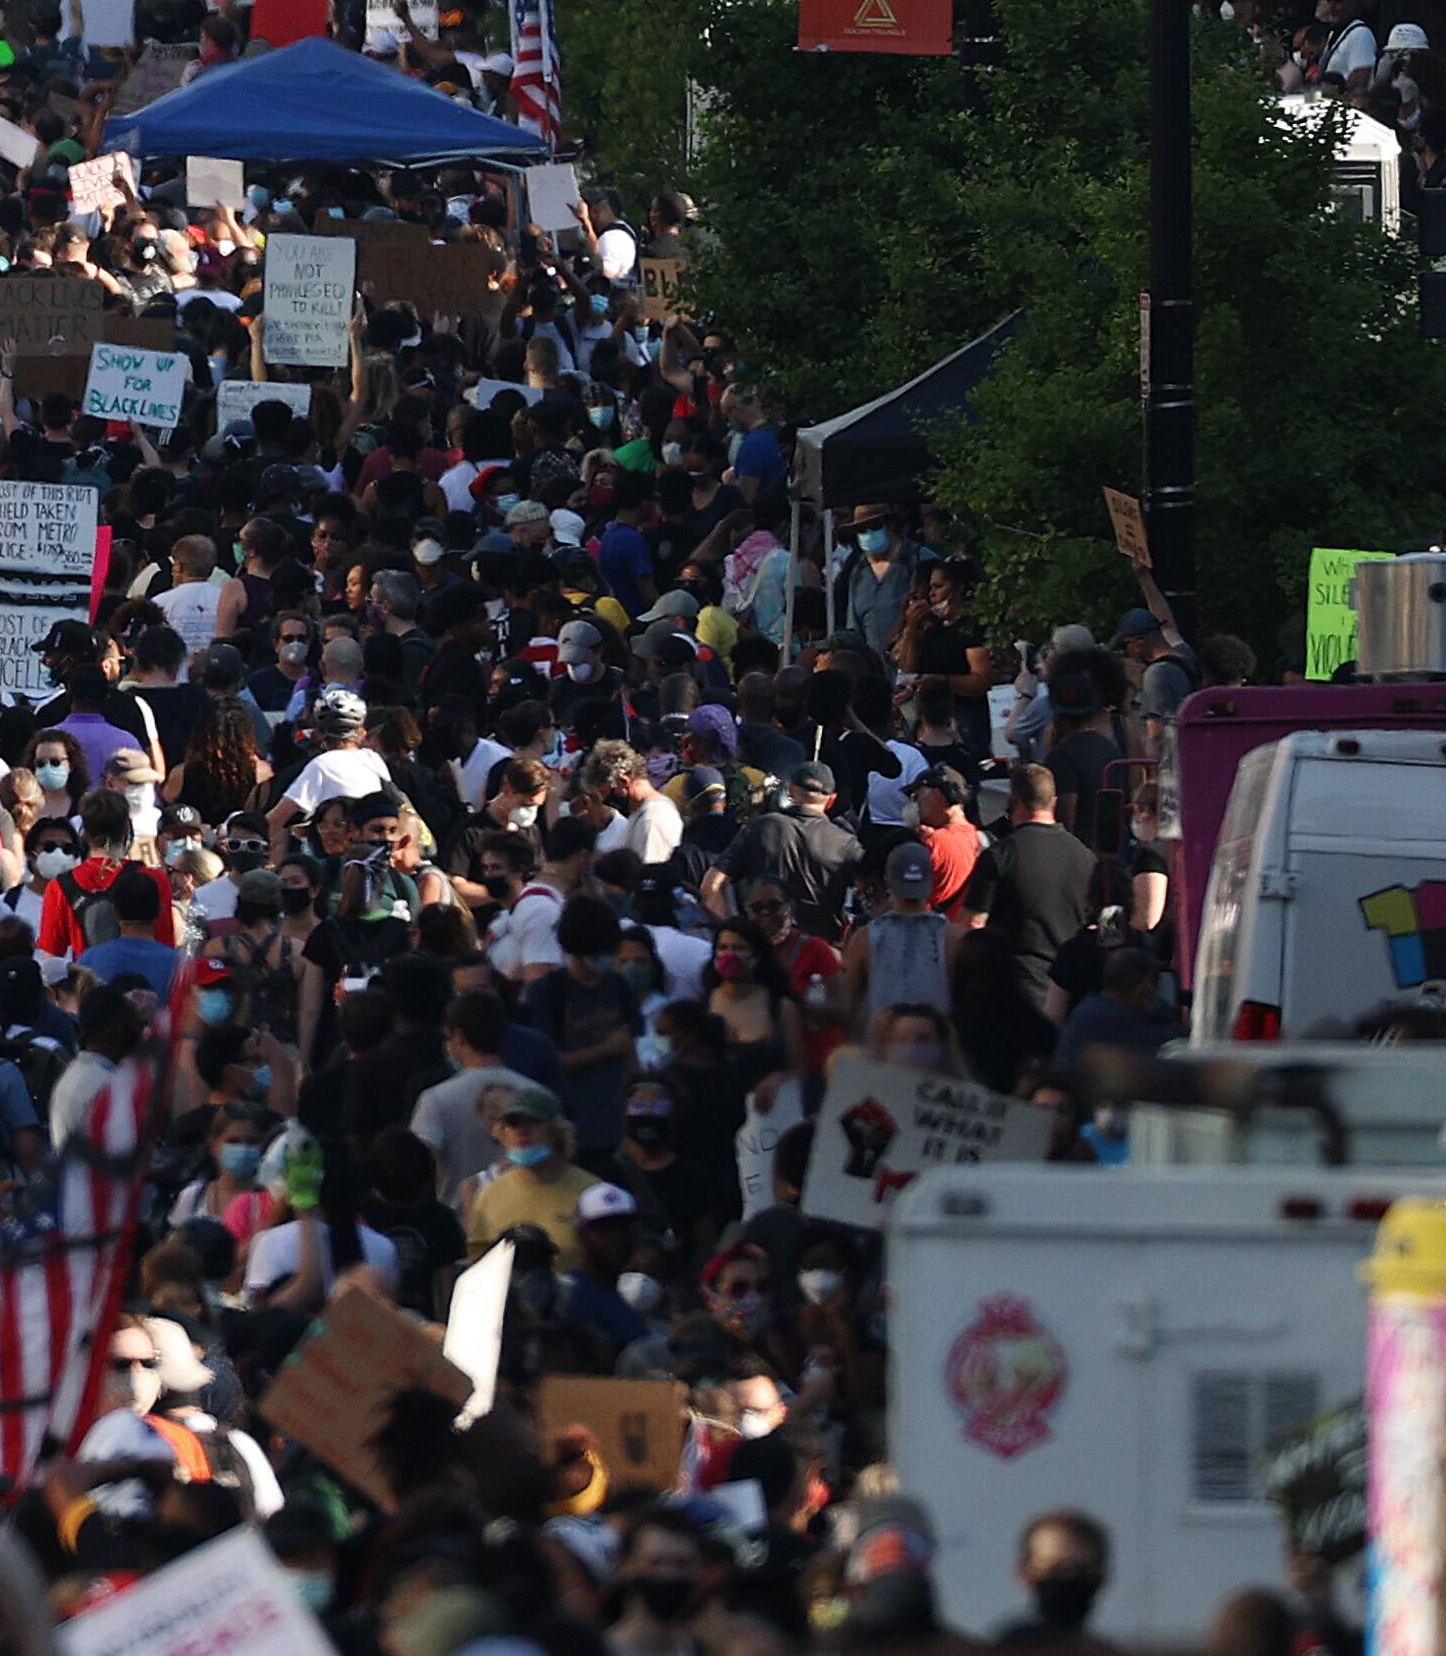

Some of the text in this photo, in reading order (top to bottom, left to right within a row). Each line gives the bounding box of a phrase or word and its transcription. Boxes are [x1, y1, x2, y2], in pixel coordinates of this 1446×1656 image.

[294, 263, 324, 280] NOT
[96, 348, 176, 372] SHOW UP
[124, 377, 152, 392] FOR
[88, 390, 178, 422] BLACK LIVES
[23, 485, 36, 499] OF
[34, 503, 77, 521] TAKEN
[37, 522, 78, 543] METRO
[1315, 583, 1350, 605] SILE
[33, 615, 49, 635] OF
[914, 1102, 1005, 1144] WHAT
